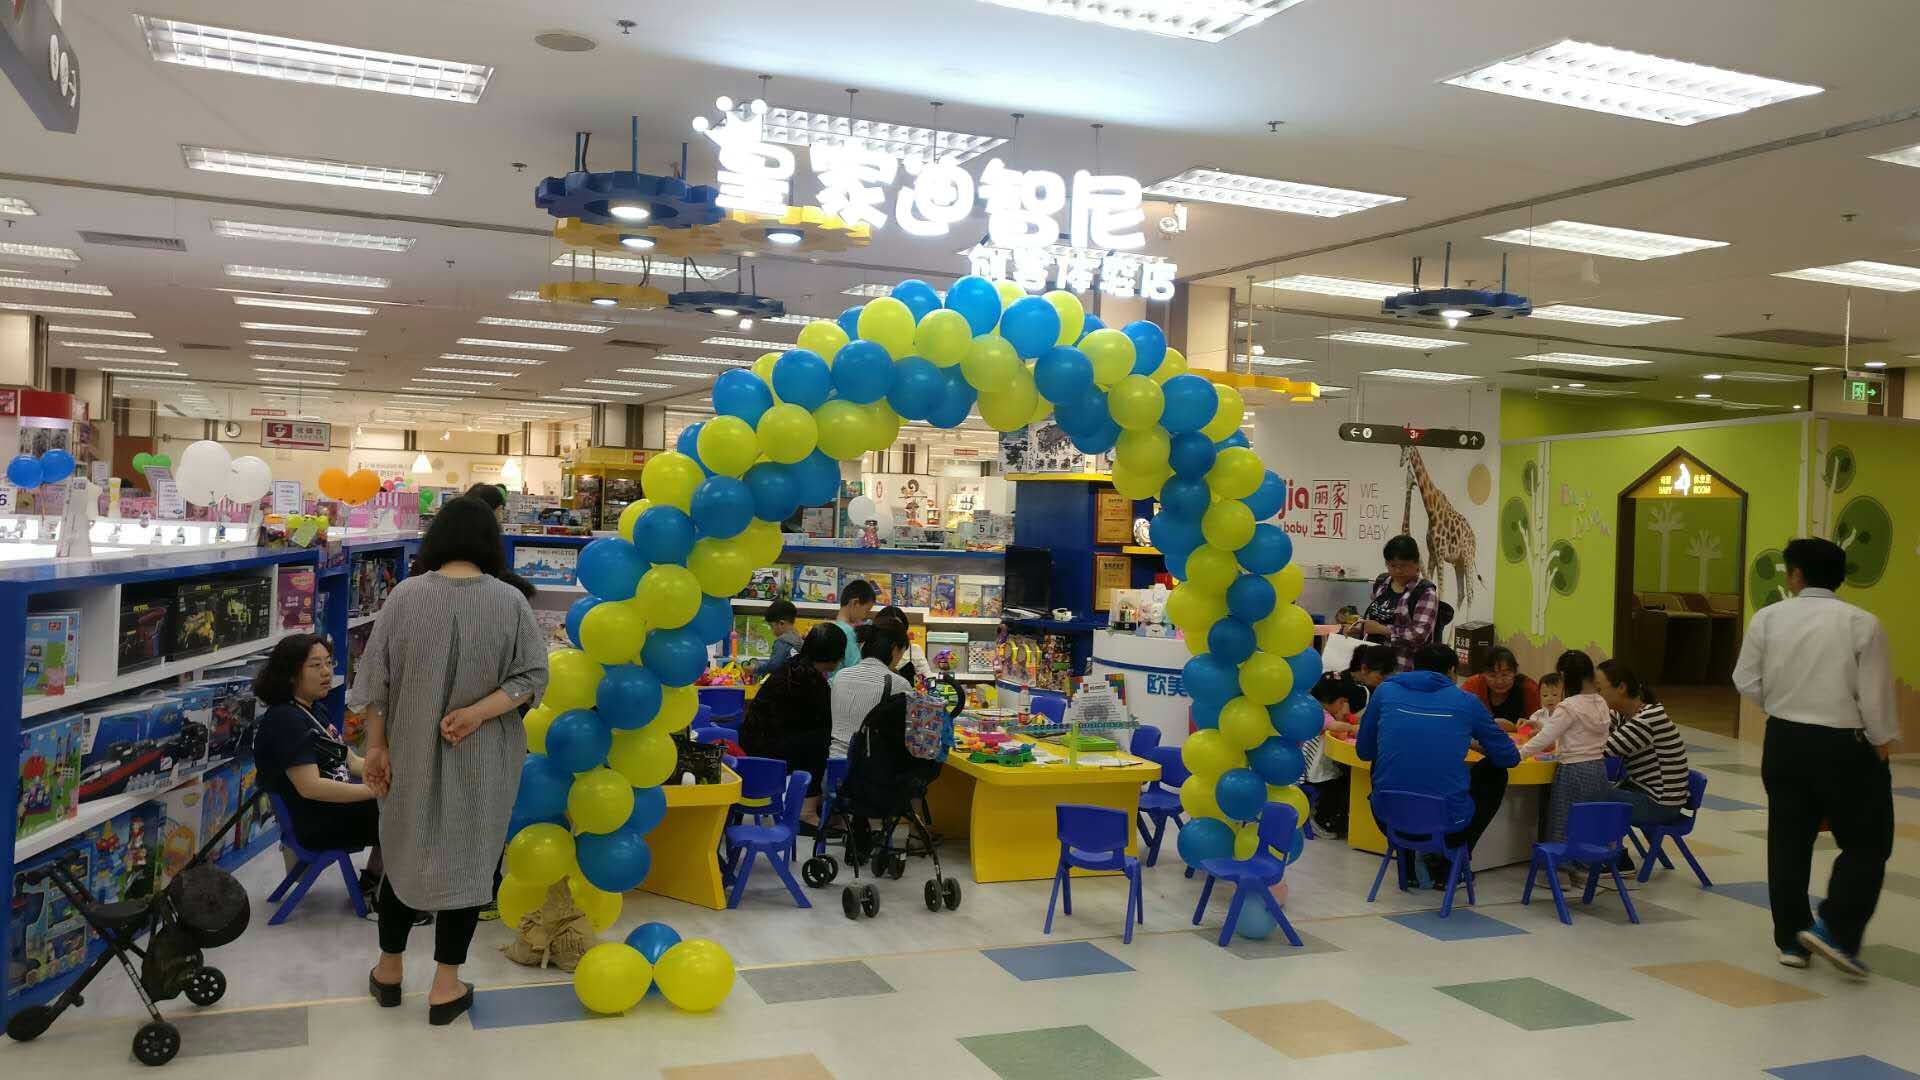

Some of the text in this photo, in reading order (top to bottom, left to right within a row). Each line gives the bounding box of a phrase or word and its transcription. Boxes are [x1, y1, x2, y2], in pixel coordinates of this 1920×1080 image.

[1314, 481, 1347, 509] 丽家
[1360, 482, 1379, 499] WE
[1359, 503, 1391, 520] LOVE
[1283, 522, 1308, 538] baby
[1313, 510, 1343, 537] 宝贝
[1359, 524, 1390, 540] BABY
[1147, 673, 1187, 697] 欧美
